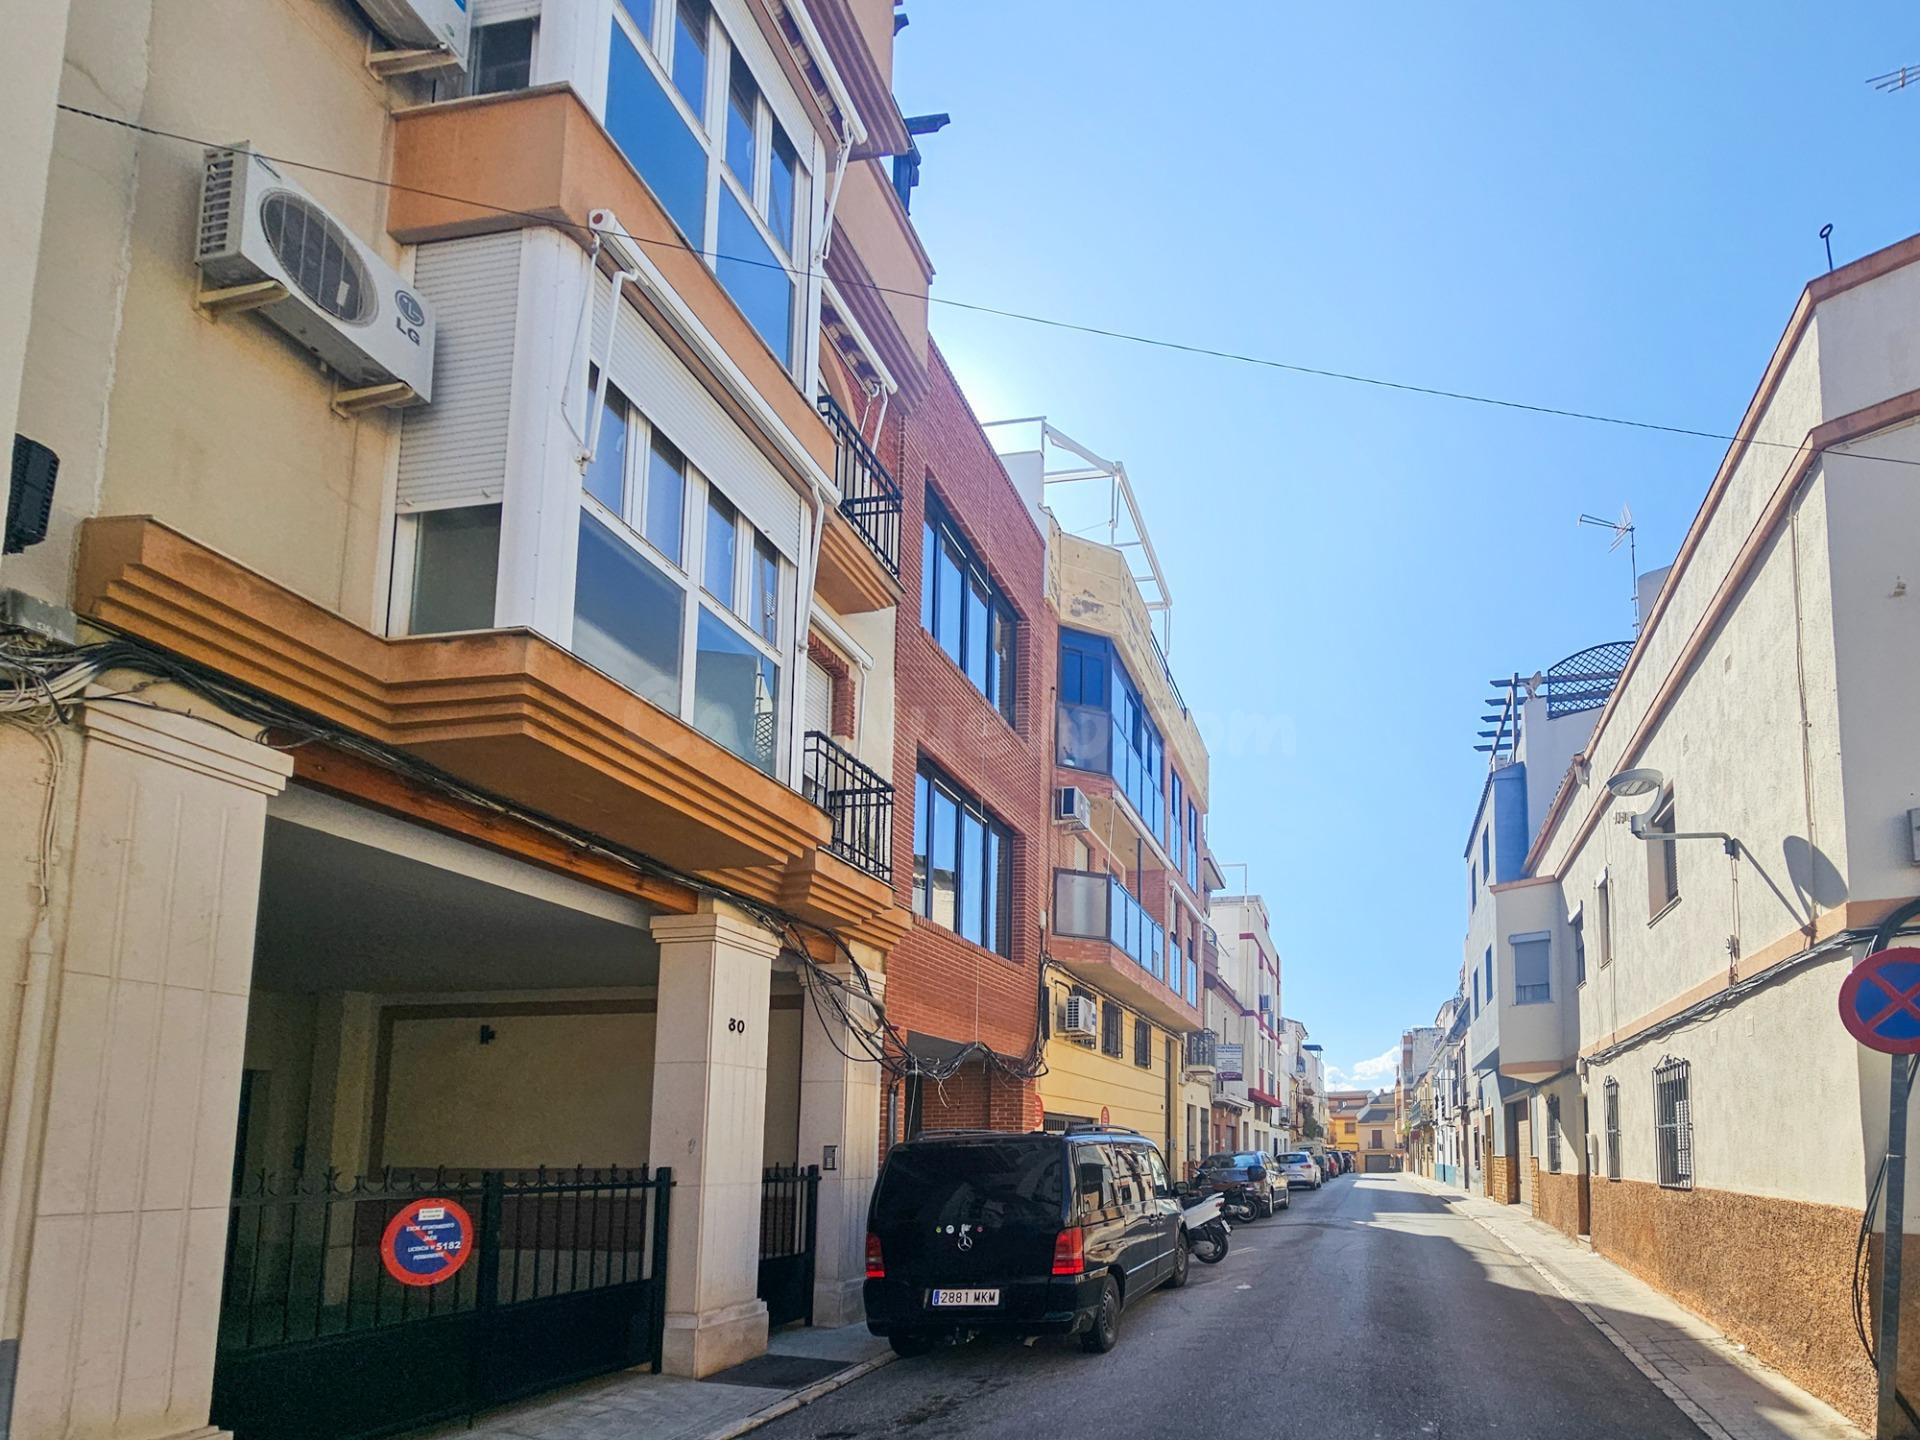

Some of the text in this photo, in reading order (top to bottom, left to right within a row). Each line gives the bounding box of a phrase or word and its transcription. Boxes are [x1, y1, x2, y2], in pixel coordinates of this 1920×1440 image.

[396, 316, 420, 346] LG
[436, 1241, 461, 1250] 5182
[941, 1291, 996, 1304] 2881 MKM
